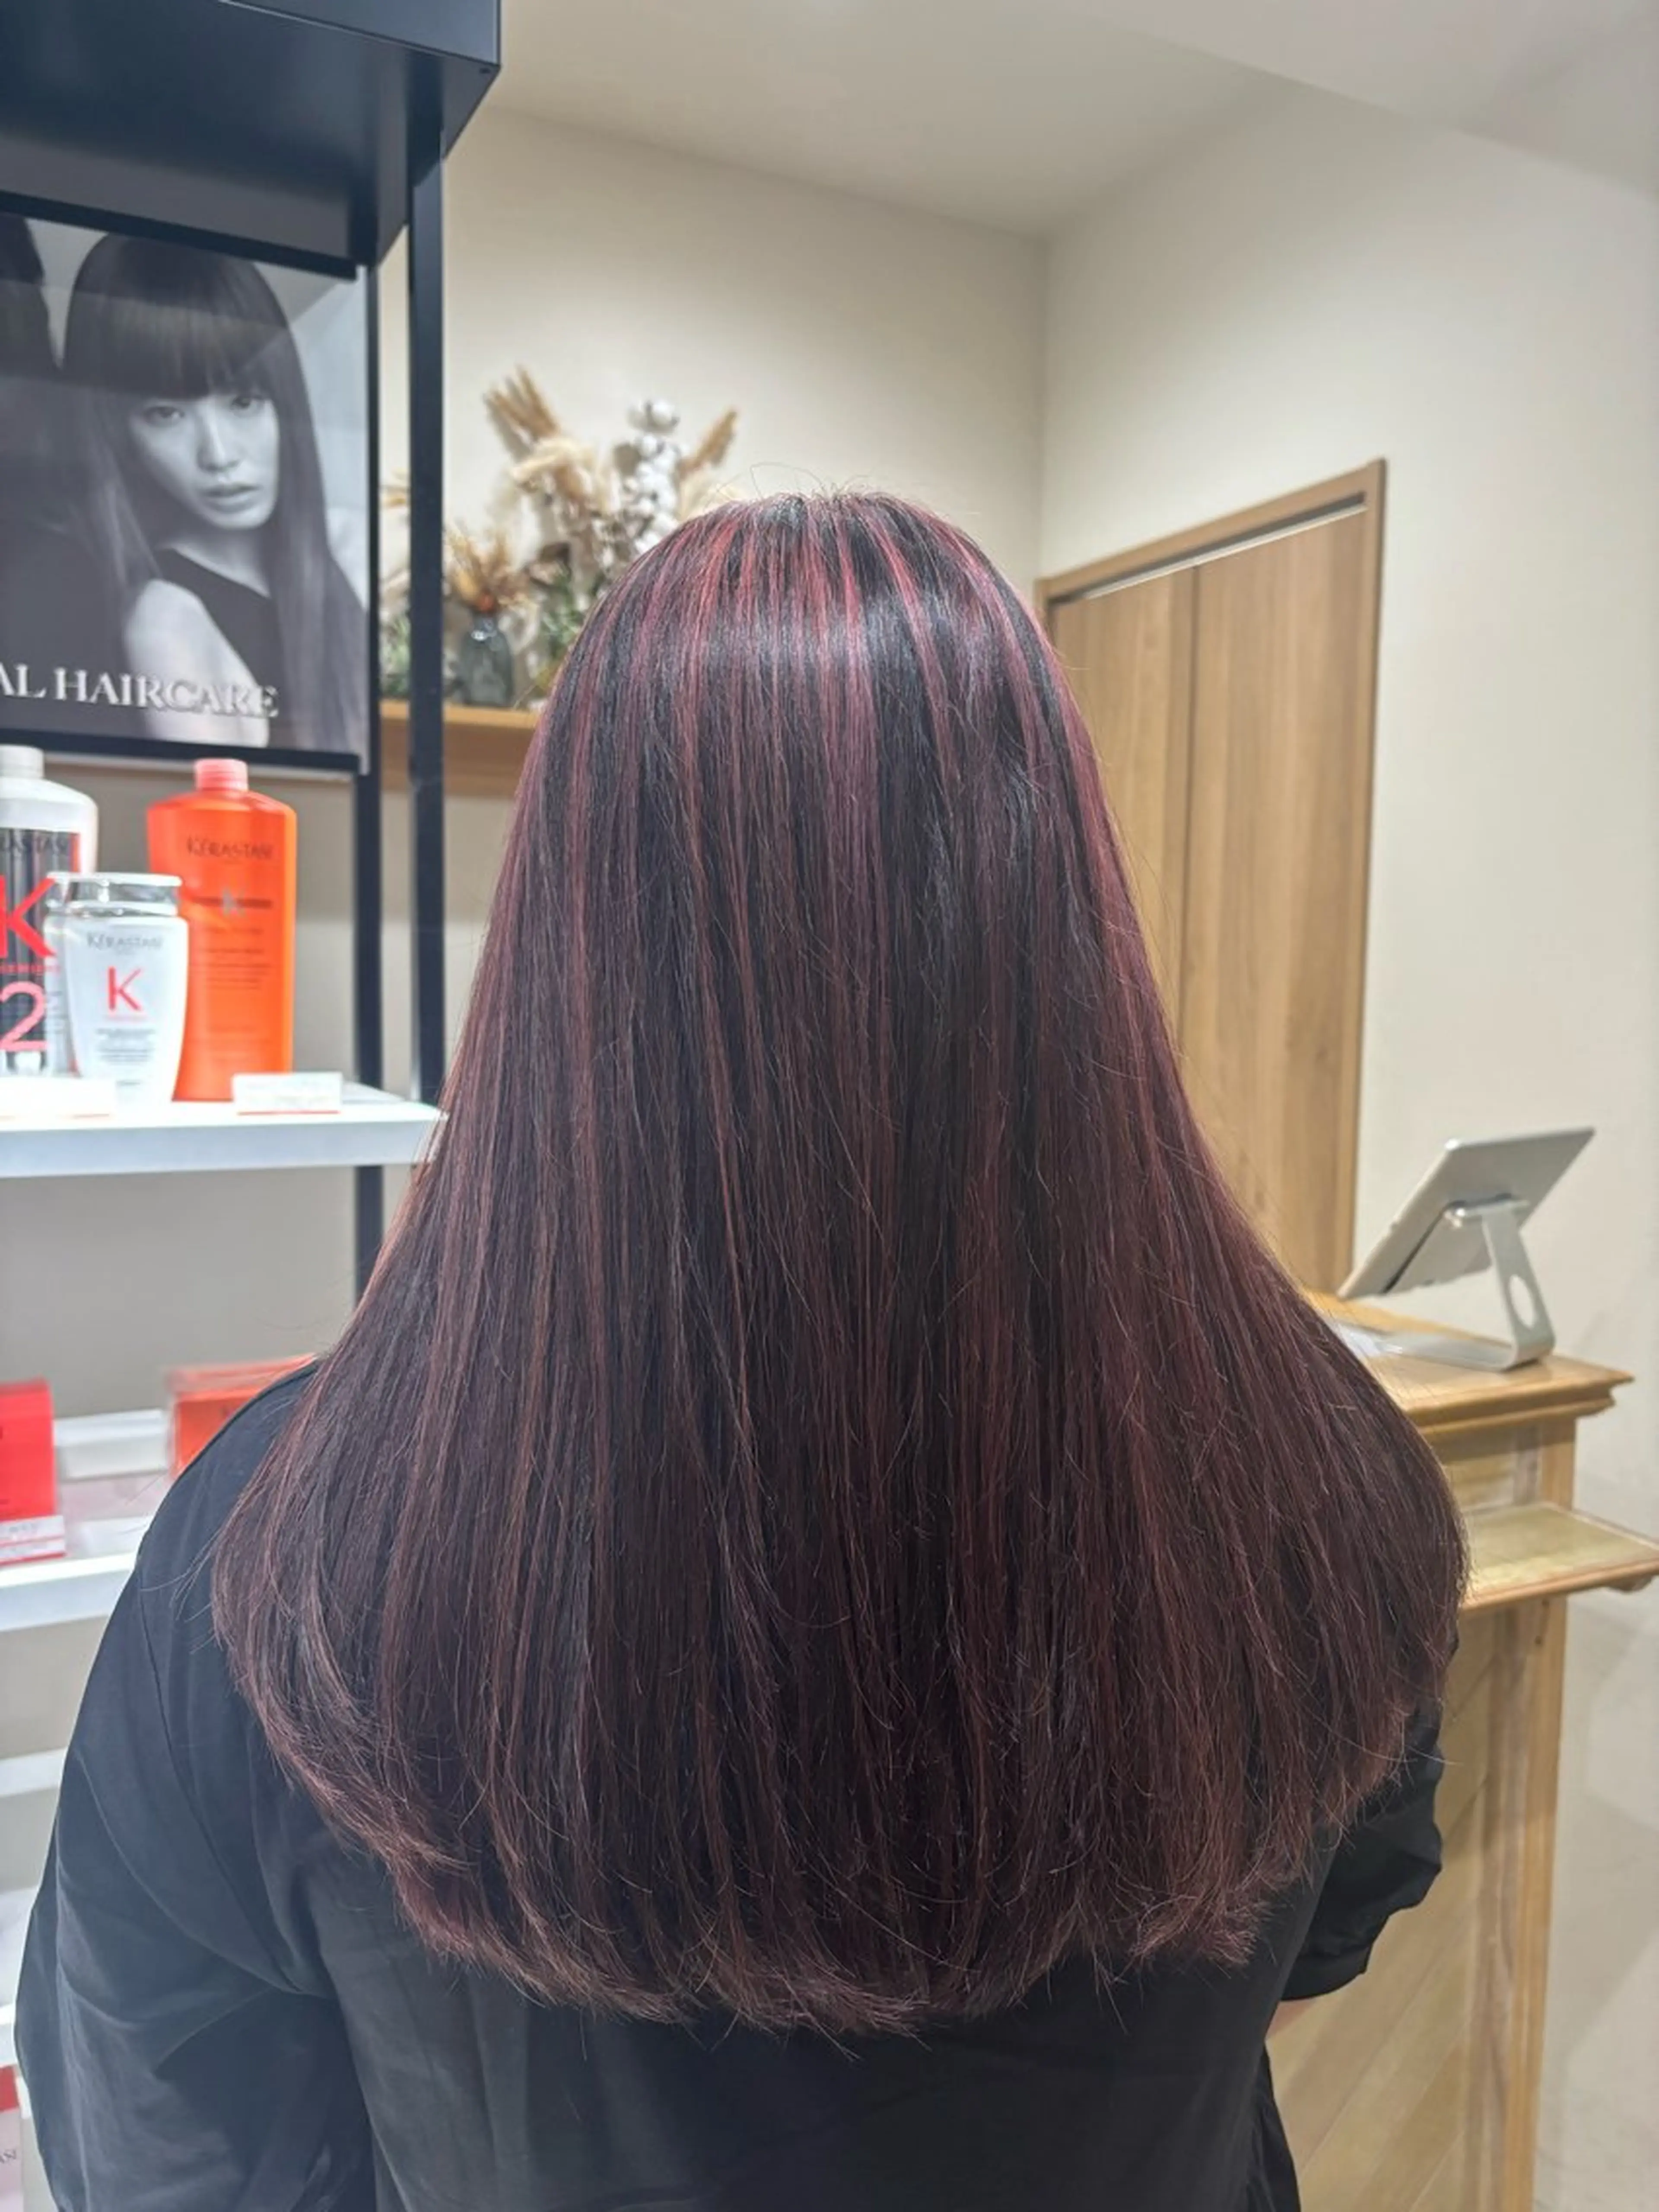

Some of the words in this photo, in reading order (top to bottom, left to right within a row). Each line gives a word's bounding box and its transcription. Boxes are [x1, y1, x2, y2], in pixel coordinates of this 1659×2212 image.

[53, 667, 279, 718] HAIRCARE
[0, 875, 56, 958] K
[0, 981, 47, 1051] 2
[108, 966, 143, 1011] K
